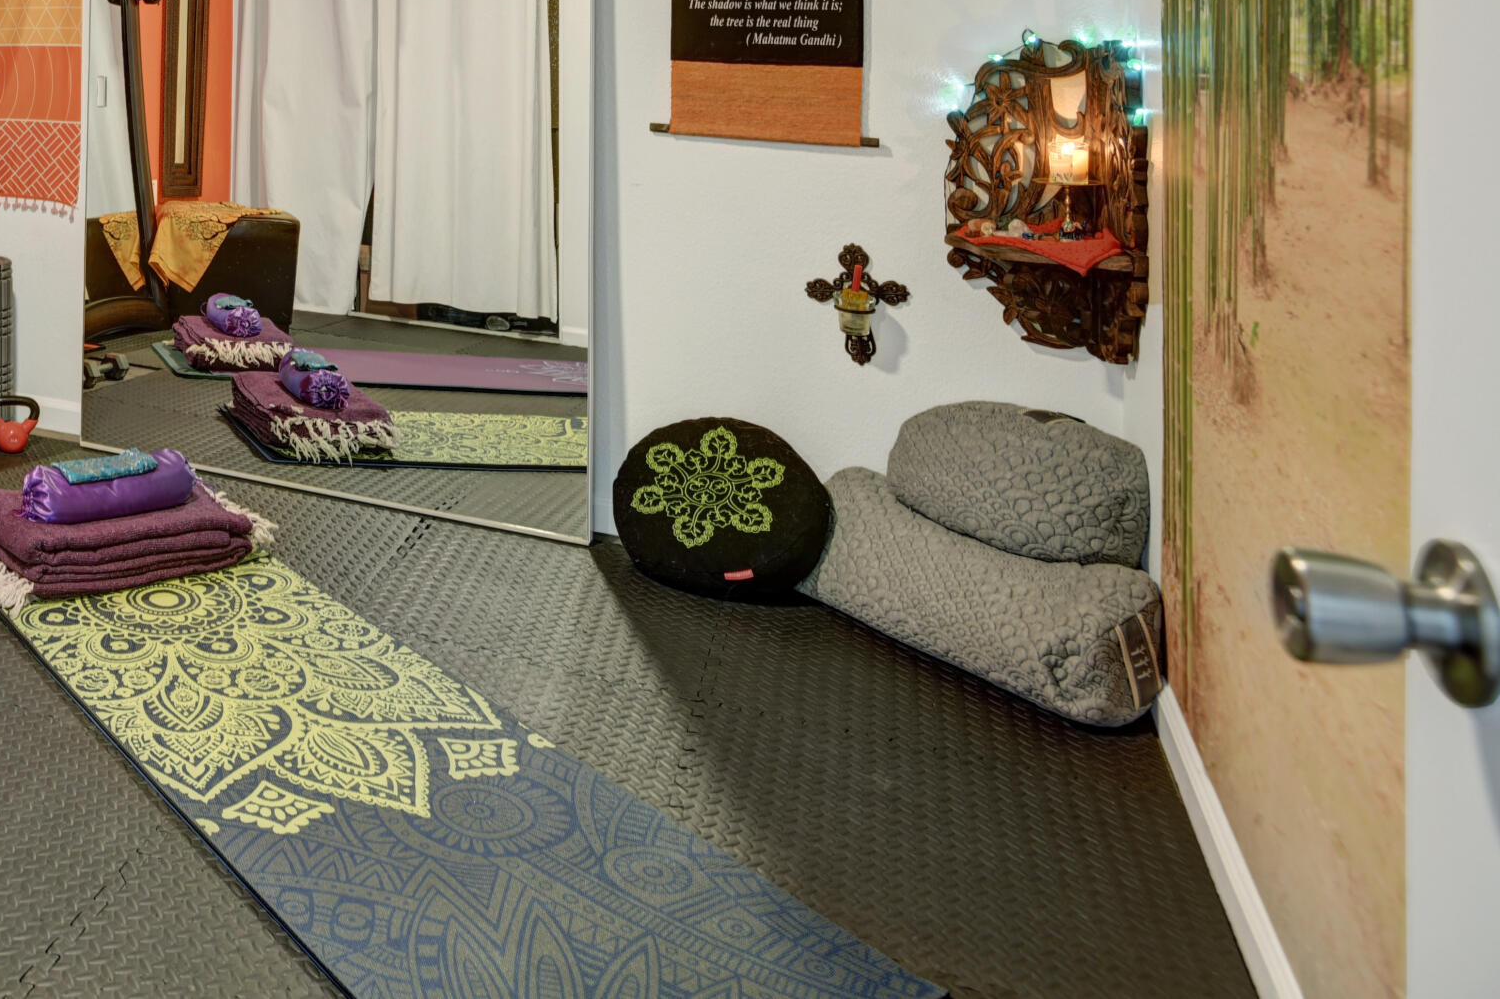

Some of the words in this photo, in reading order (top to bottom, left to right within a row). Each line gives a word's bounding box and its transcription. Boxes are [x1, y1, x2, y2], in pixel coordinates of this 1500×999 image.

[779, 1, 792, 11] we
[709, 13, 725, 27] the
[726, 16, 744, 27] tree
[746, 14, 754, 28] is
[755, 14, 771, 28] the
[773, 14, 792, 28] real
[793, 14, 819, 32] thing
